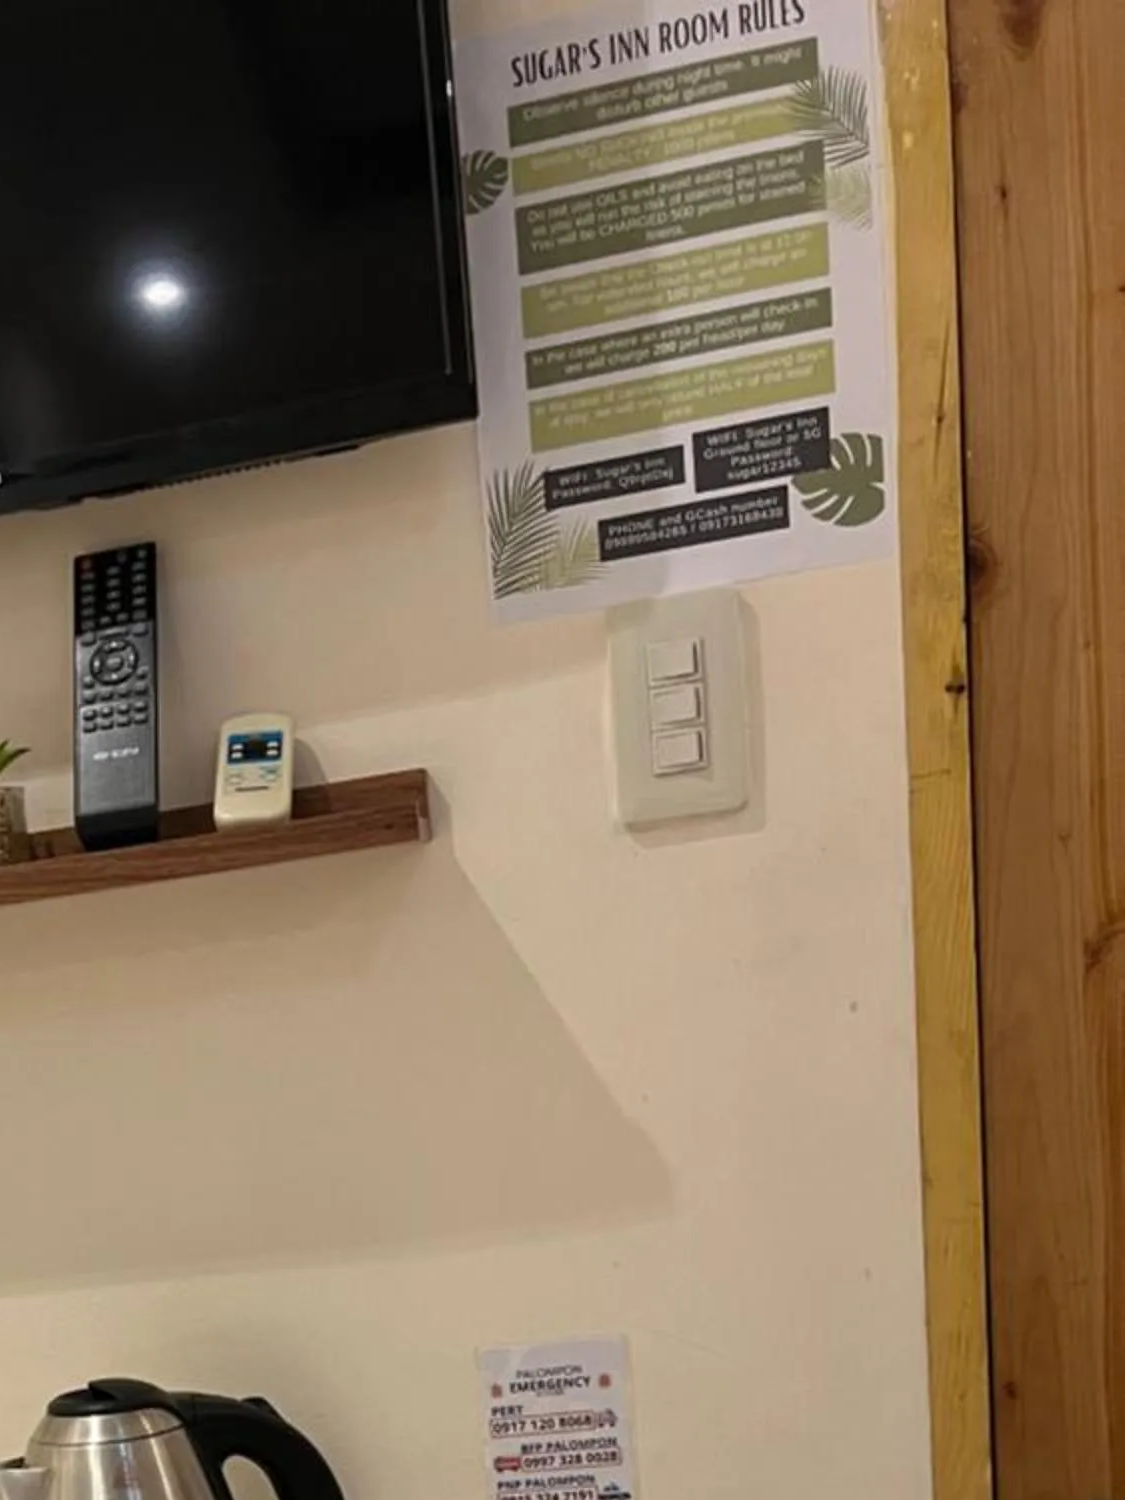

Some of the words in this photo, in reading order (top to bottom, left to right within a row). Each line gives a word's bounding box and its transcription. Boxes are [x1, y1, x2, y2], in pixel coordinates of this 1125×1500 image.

[511, 39, 601, 87] SUGAR'S
[610, 27, 650, 65] INN
[659, 9, 728, 53] ROOM
[739, 0, 805, 36] RULES
[508, 1375, 591, 1394] EMERGENCY
[546, 1436, 618, 1453] PALOMPON
